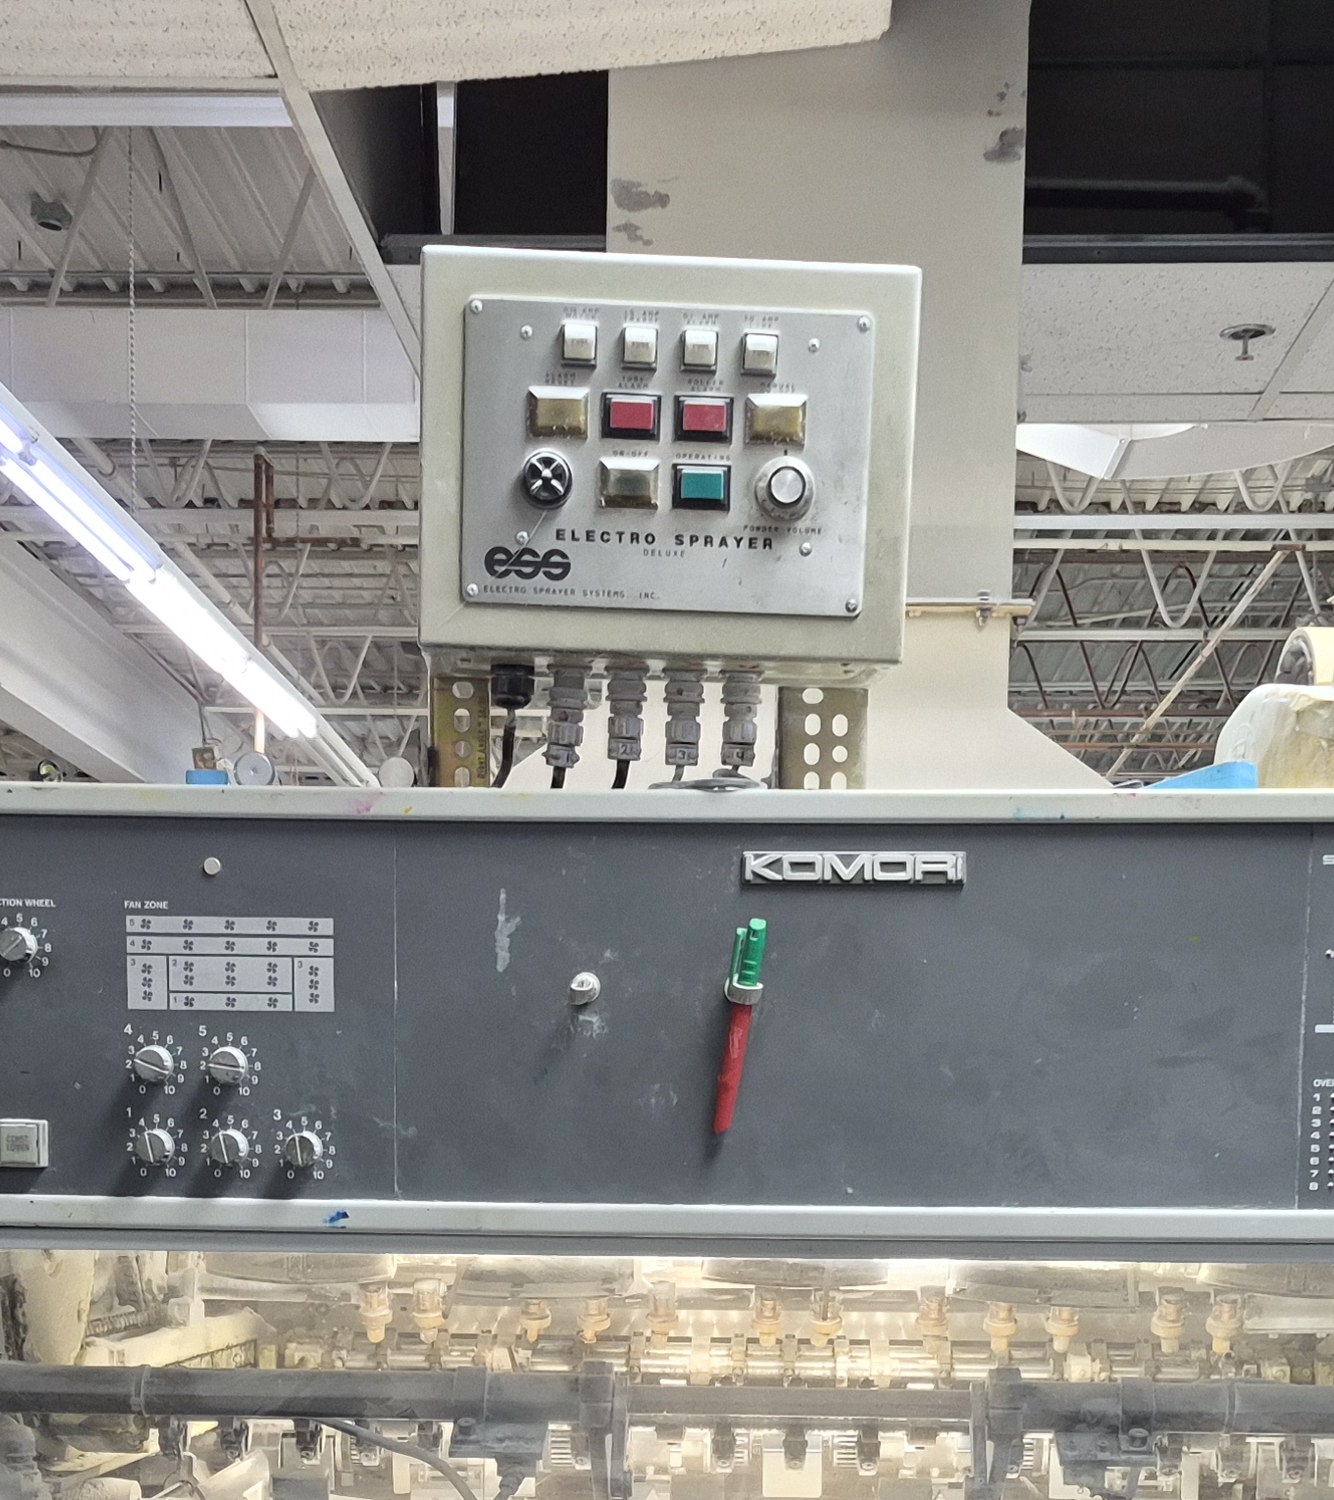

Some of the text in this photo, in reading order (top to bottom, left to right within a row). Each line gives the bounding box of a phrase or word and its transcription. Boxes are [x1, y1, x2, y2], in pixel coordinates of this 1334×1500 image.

[675, 453, 731, 461] OPERATING
[743, 525, 823, 535] POWDER VOLUME
[555, 528, 773, 550] ELECTRO SPRAYER
[643, 548, 686, 558] DELUXE
[484, 585, 526, 594] ELECTRO
[533, 586, 576, 596] SPRAYER
[745, 853, 964, 881] KOMORI
[24, 899, 56, 908] WHEEL
[124, 900, 169, 910] FAN ZONE
[0, 917, 8, 926] 4
[16, 913, 23, 922] 5
[31, 918, 38, 927] 6
[40, 929, 47, 938] 7
[44, 943, 52, 952] 8
[41, 957, 49, 966] 9
[3, 968, 11, 976] 0
[29, 968, 41, 977] 10
[123, 1023, 132, 1035] 4
[198, 1025, 207, 1036] 5
[1312, 1093, 1321, 1101] 1
[126, 1107, 131, 1117] 1
[199, 1108, 208, 1119] 2
[273, 1109, 282, 1120] 3
[1312, 1106, 1322, 1114] 2
[1311, 1119, 1321, 1127] 3
[1310, 1131, 1320, 1139] 4
[1310, 1144, 1320, 1152] 5
[1309, 1157, 1319, 1165] 6
[1310, 1169, 1319, 1177] 7
[1309, 1182, 1319, 1190] 8
